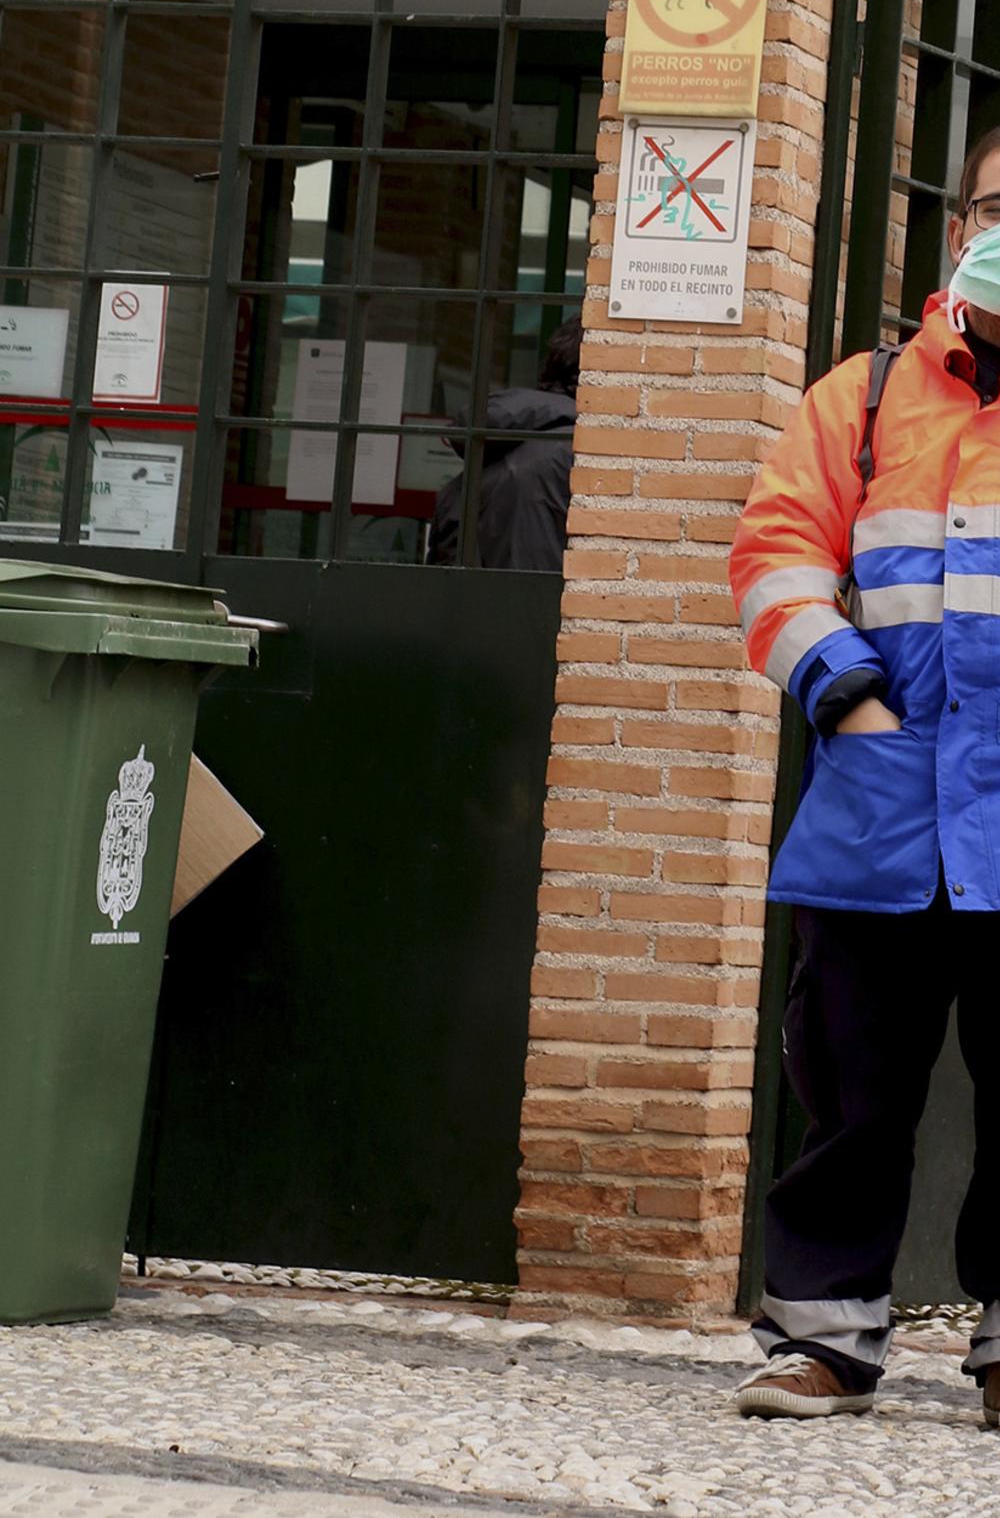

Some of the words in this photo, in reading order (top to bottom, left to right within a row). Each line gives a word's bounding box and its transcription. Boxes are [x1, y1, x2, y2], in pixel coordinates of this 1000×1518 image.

[632, 55, 703, 71] PERROS
[631, 75, 678, 87] excepto
[681, 76, 720, 88] perros
[628, 260, 687, 275] PROHIBIDO
[690, 263, 728, 277] FUMAR
[621, 279, 635, 291] EN
[639, 280, 667, 292] TODO
[670, 281, 683, 293] EL
[686, 282, 733, 296] RECINTO
